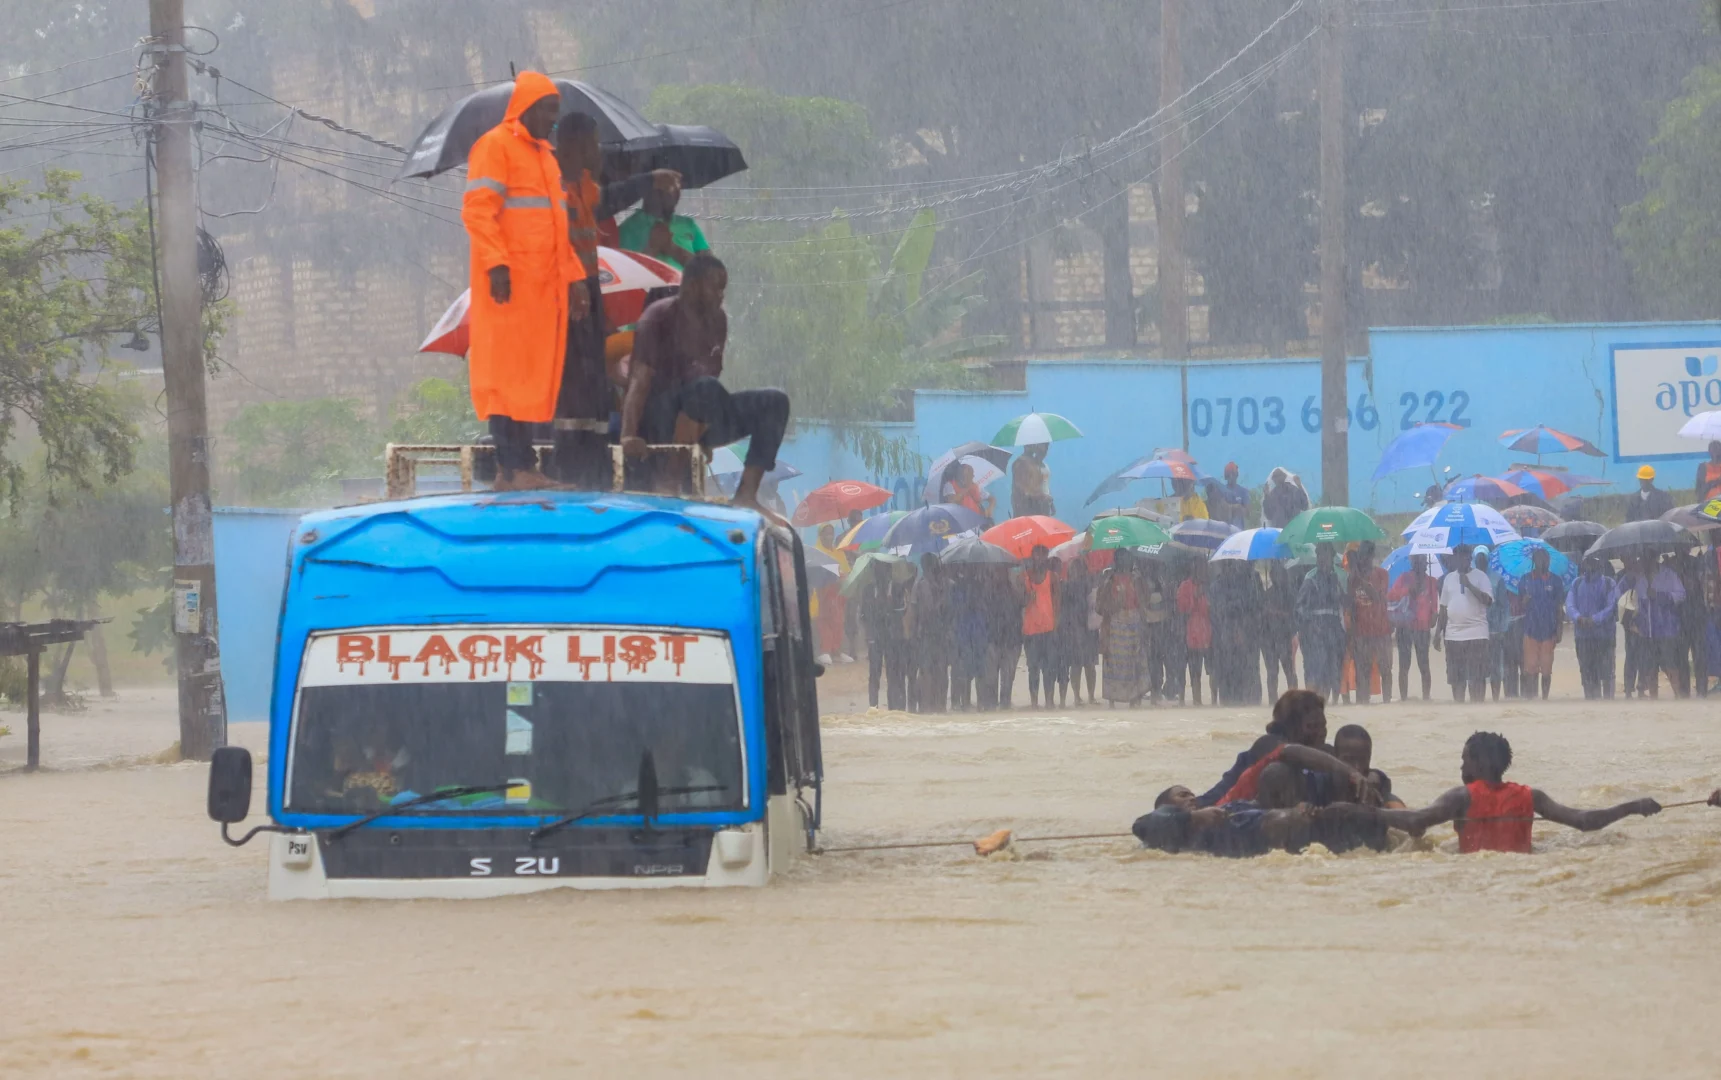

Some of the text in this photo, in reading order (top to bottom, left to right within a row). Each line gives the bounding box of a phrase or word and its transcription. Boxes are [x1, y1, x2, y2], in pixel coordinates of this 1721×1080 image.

[1190, 390, 1471, 437] 0703 66 222
[336, 634, 699, 678] BLACK LIST
